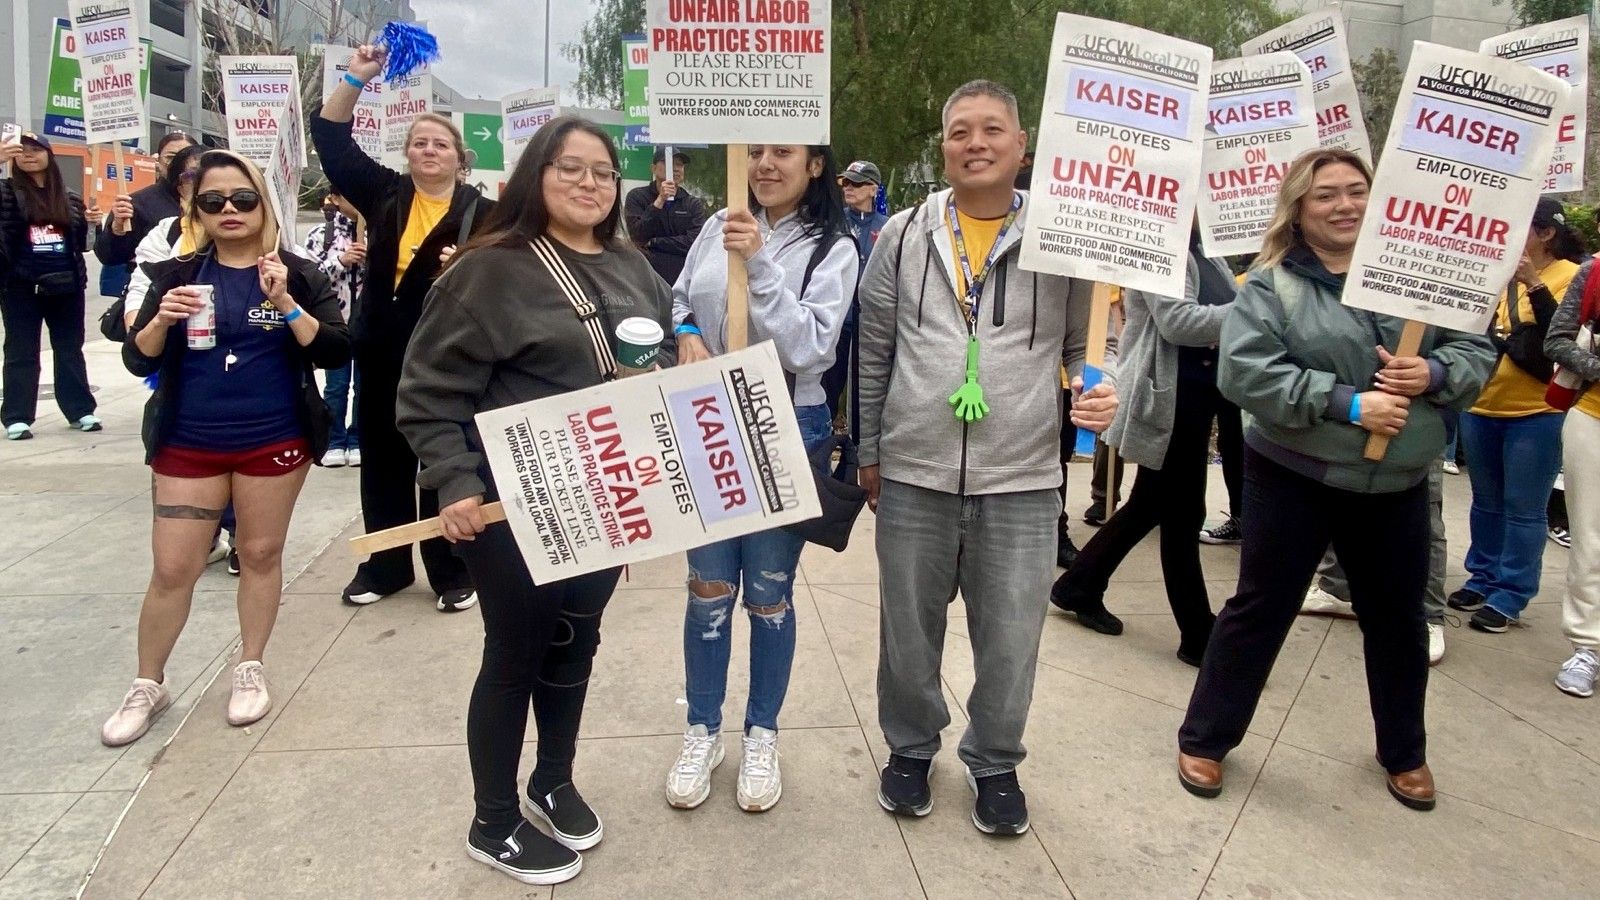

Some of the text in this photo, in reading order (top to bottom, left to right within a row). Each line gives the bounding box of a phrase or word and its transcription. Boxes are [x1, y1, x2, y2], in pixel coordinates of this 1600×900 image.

[668, 0, 810, 24] UNFAIR LABOR
[85, 28, 126, 45] KAISER
[652, 28, 824, 53] PRACTICE STRIKE
[1496, 39, 1527, 56] UFCW
[92, 52, 126, 64] EMPLOYEES
[674, 54, 805, 70] PLEASE RESPECT
[1078, 49, 1100, 60] VOICE
[1102, 54, 1115, 62] FOR
[1118, 56, 1153, 71] WORKING
[1154, 63, 1195, 81] CALIFORNIA
[1084, 34, 1200, 73] UFCW Local 770
[88, 73, 132, 93] UNFAIR
[104, 64, 114, 75] ON
[666, 72, 813, 88] OUR PICKET LINE
[1245, 65, 1275, 80] Local
[1279, 62, 1300, 76] 770
[1264, 74, 1298, 85] CALIFORNIA
[240, 84, 289, 94] KAISER
[400, 90, 410, 101] ON
[1077, 78, 1180, 120] KAISER
[1431, 81, 1454, 92] VOICE
[1455, 86, 1470, 96] FOR
[1472, 90, 1507, 105] WORKING
[1508, 98, 1548, 116] CALIFORNIA
[1438, 64, 1557, 106] UFCW Local 770
[258, 109, 271, 118] ON
[358, 108, 372, 116] ON
[386, 100, 427, 117] UNFAIR
[658, 98, 821, 108] UNITED FOOD AND COMMERCIAL
[660, 108, 820, 118] WORKERS UNION LOCAL NO. 770
[1209, 100, 1293, 126] KAISER
[234, 118, 278, 130] UNFA
[1077, 121, 1170, 150] EMPLOYEES
[1328, 120, 1352, 135] STRIKE
[1416, 108, 1520, 155] KAISER
[1216, 131, 1292, 150] EMPLOYEES
[1108, 145, 1135, 167] ON
[1245, 147, 1266, 164] ON
[1053, 157, 1180, 203] UNFAIR
[1416, 157, 1508, 190] EMPLOYEES
[1050, 183, 1177, 219] LABOR PRACTICE STRIKE
[1211, 190, 1239, 202] LABOR
[1220, 201, 1257, 211] PLEASE
[1444, 184, 1472, 207] ON
[1059, 204, 1165, 233] PLEASE RESPECT
[1212, 223, 1256, 234] UNITED FOOD
[1219, 211, 1242, 221] OUR
[1385, 197, 1510, 245] UNFAIR
[1054, 216, 1165, 247] OUR PICKET LINE
[1214, 231, 1247, 241] WORKERS
[1380, 224, 1505, 261] LABOR PRACTICE STRIKE
[1039, 242, 1171, 276] WORKERS UNION LOCAL NO. 770
[1041, 232, 1173, 266] UNITED FOOD AND COMMERCIAL
[1385, 242, 1488, 272] PLEASE RESPECT
[1379, 254, 1486, 287] OUR PICKET LINE
[1362, 280, 1487, 315] WORKERS UNION LOCAL NO. 770
[1364, 270, 1490, 305] UNITED FOOD AND COMMERCIAL
[692, 395, 746, 511] KAISER
[733, 372, 742, 380] A
[749, 424, 765, 464] WORKING
[761, 465, 779, 510] CALIFORNIA
[748, 379, 799, 509] UFCW Local 770
[587, 406, 652, 544] UNFAIR
[635, 456, 661, 487] ON
[651, 412, 692, 514] EMPLOYEES
[516, 423, 572, 563] UNITED FOOD AND COMMERCIAL
[540, 430, 587, 549] OUR PICKET LINE
[555, 428, 601, 542] PLEASE RESPECT
[567, 413, 625, 549] LABOR PRACTICE STRIKE
[504, 426, 560, 566] WORKERS UNION LOCAL NO. 770
